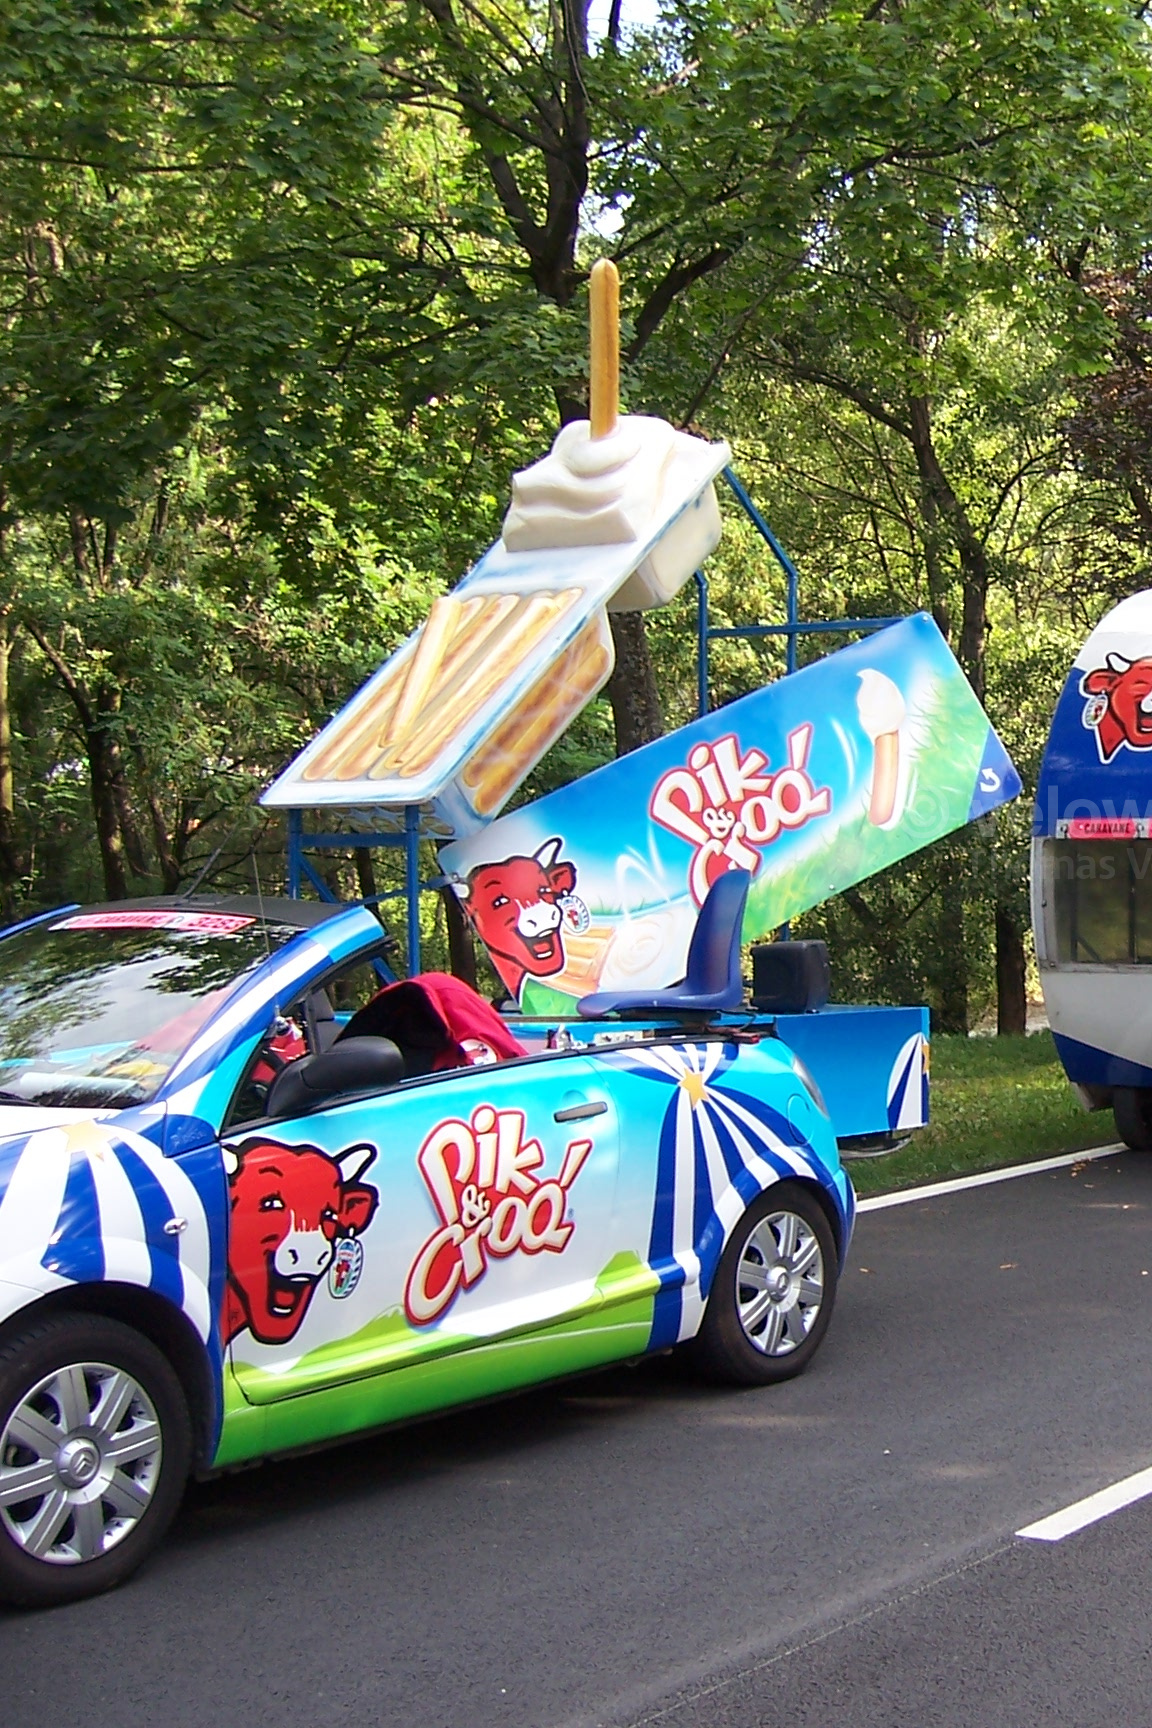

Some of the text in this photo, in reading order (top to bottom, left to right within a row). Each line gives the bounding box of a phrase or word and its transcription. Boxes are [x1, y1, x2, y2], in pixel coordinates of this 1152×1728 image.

[652, 736, 773, 846] Pik
[702, 807, 736, 839] &
[1084, 823, 1130, 833] CARAVANE
[421, 1108, 543, 1225] Pik
[461, 1184, 491, 1228] &
